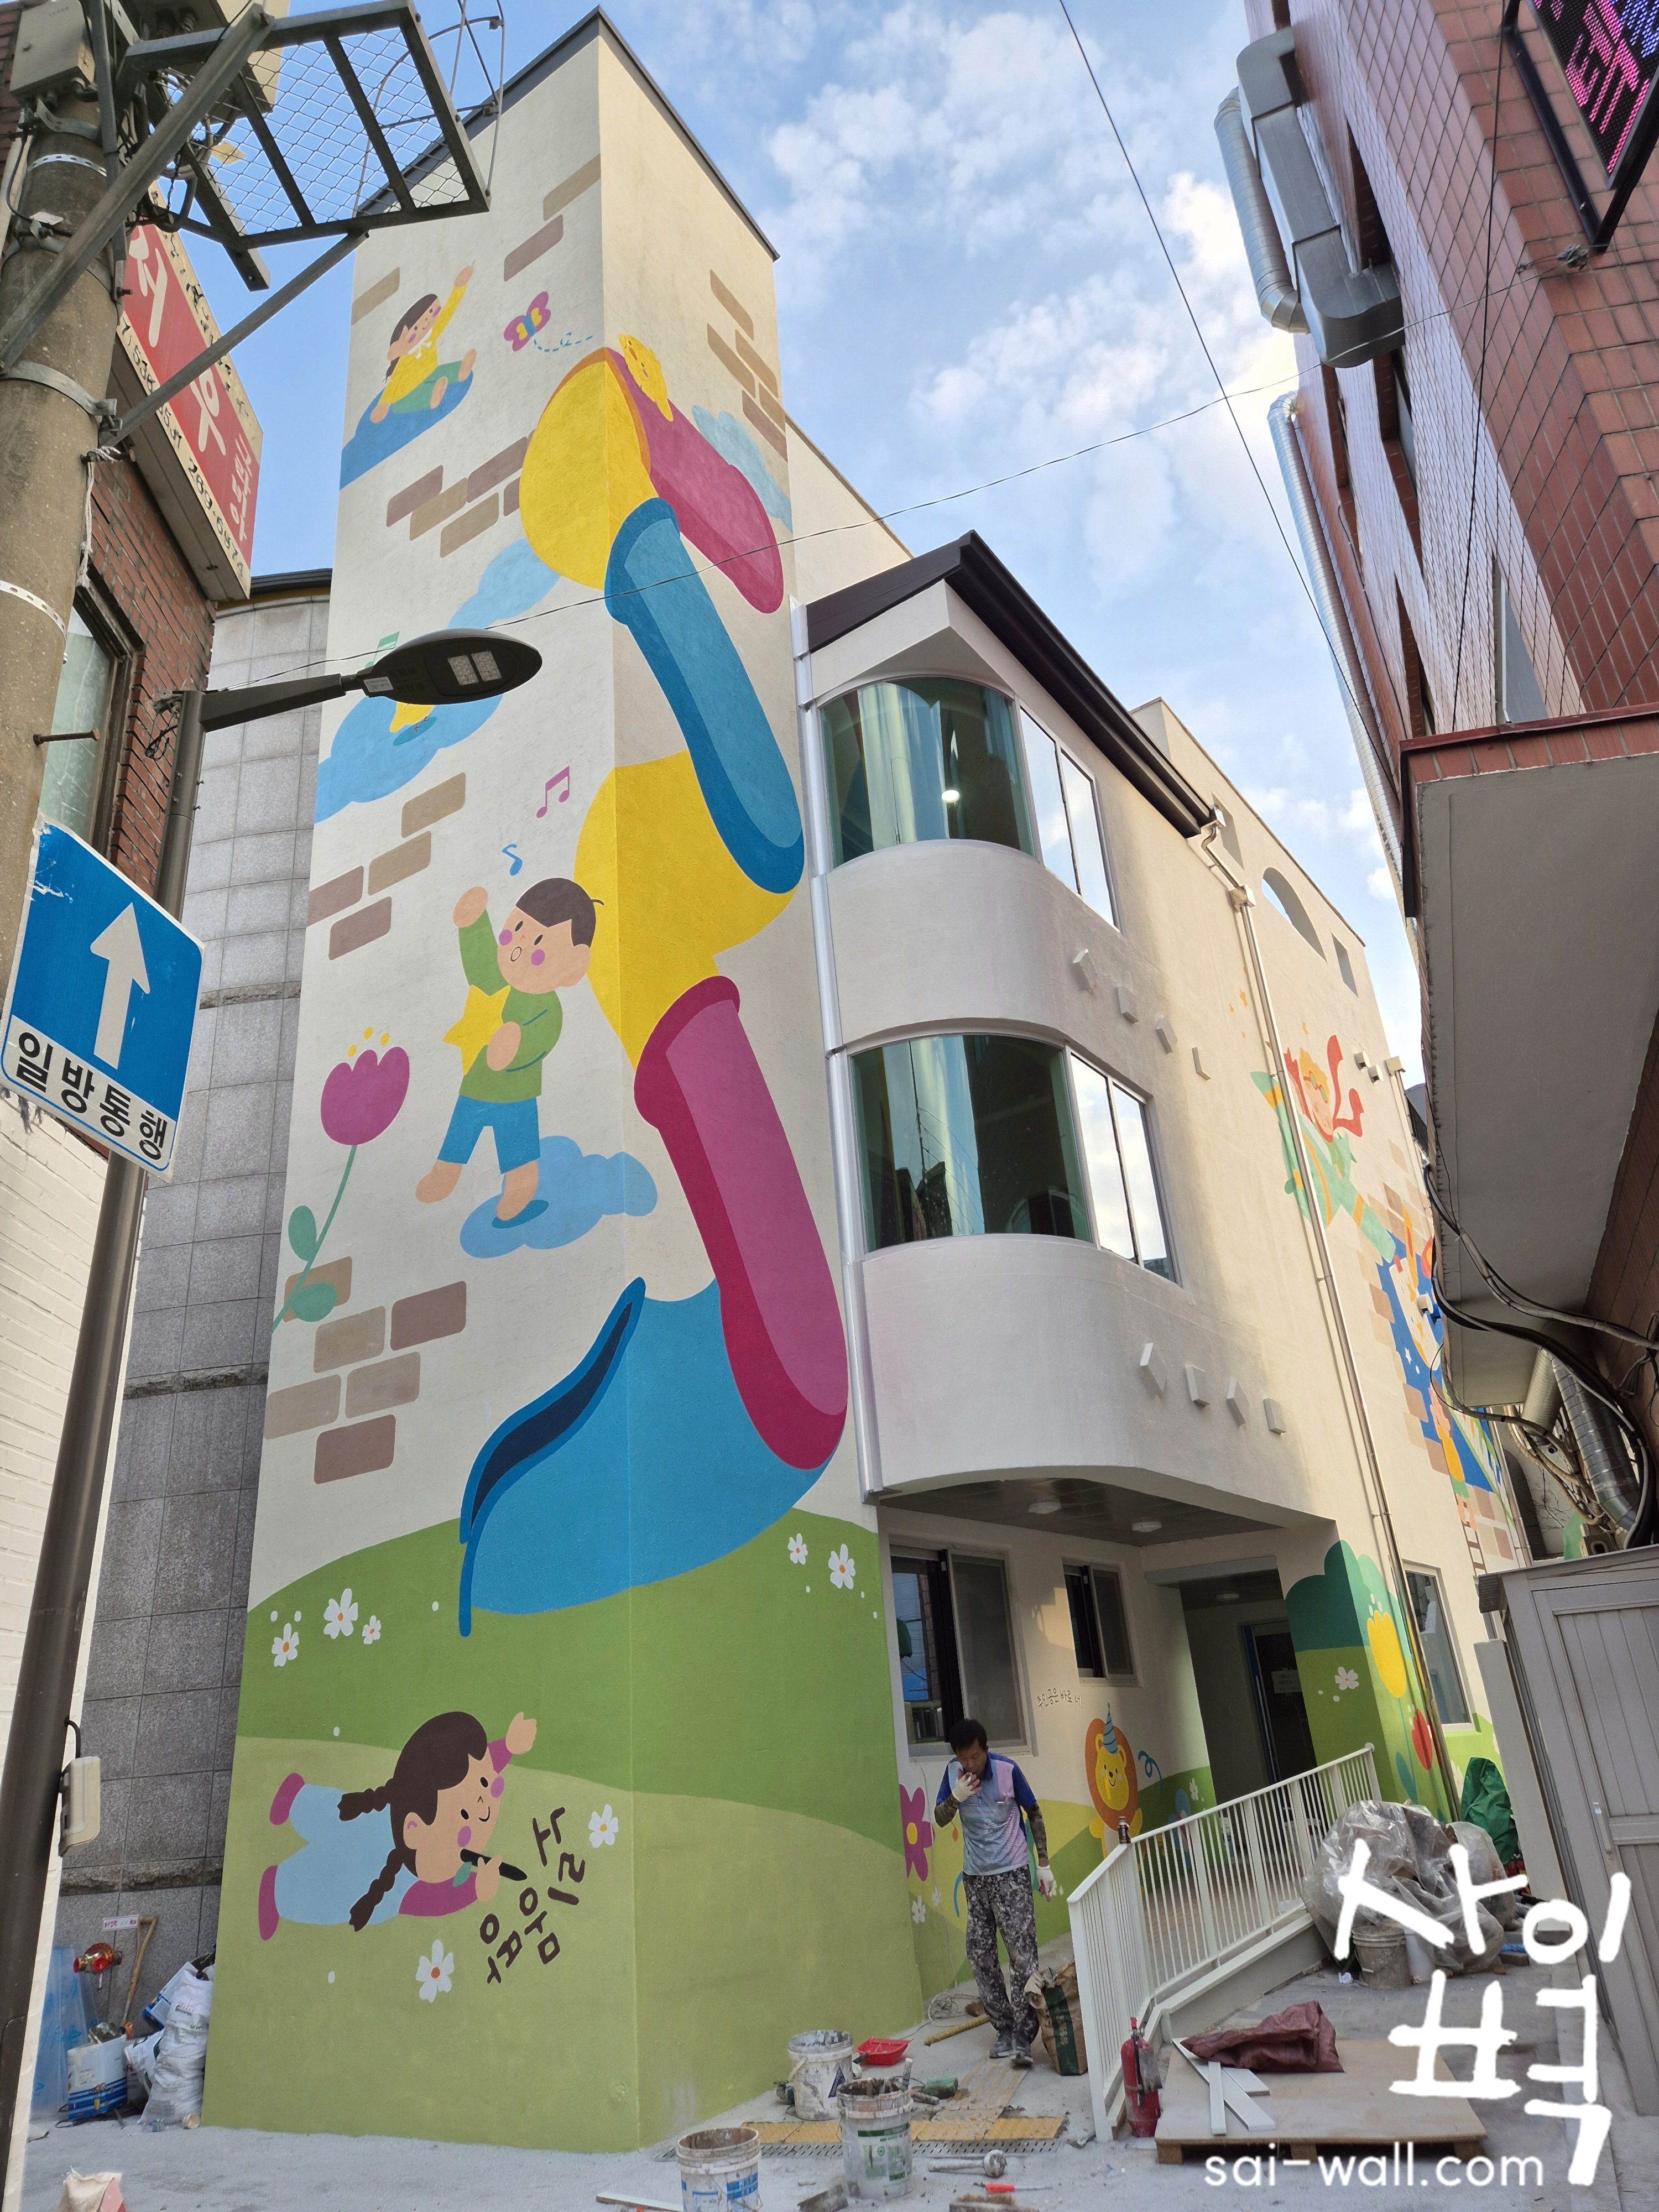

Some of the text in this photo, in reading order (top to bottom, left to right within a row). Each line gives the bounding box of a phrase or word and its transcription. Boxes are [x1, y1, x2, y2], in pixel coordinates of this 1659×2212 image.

[229, 432, 253, 542] 그라비아
[15, 1031, 168, 1161] 일방통행
[1036, 1688, 1083, 1710] 주인공은 바로 너!
